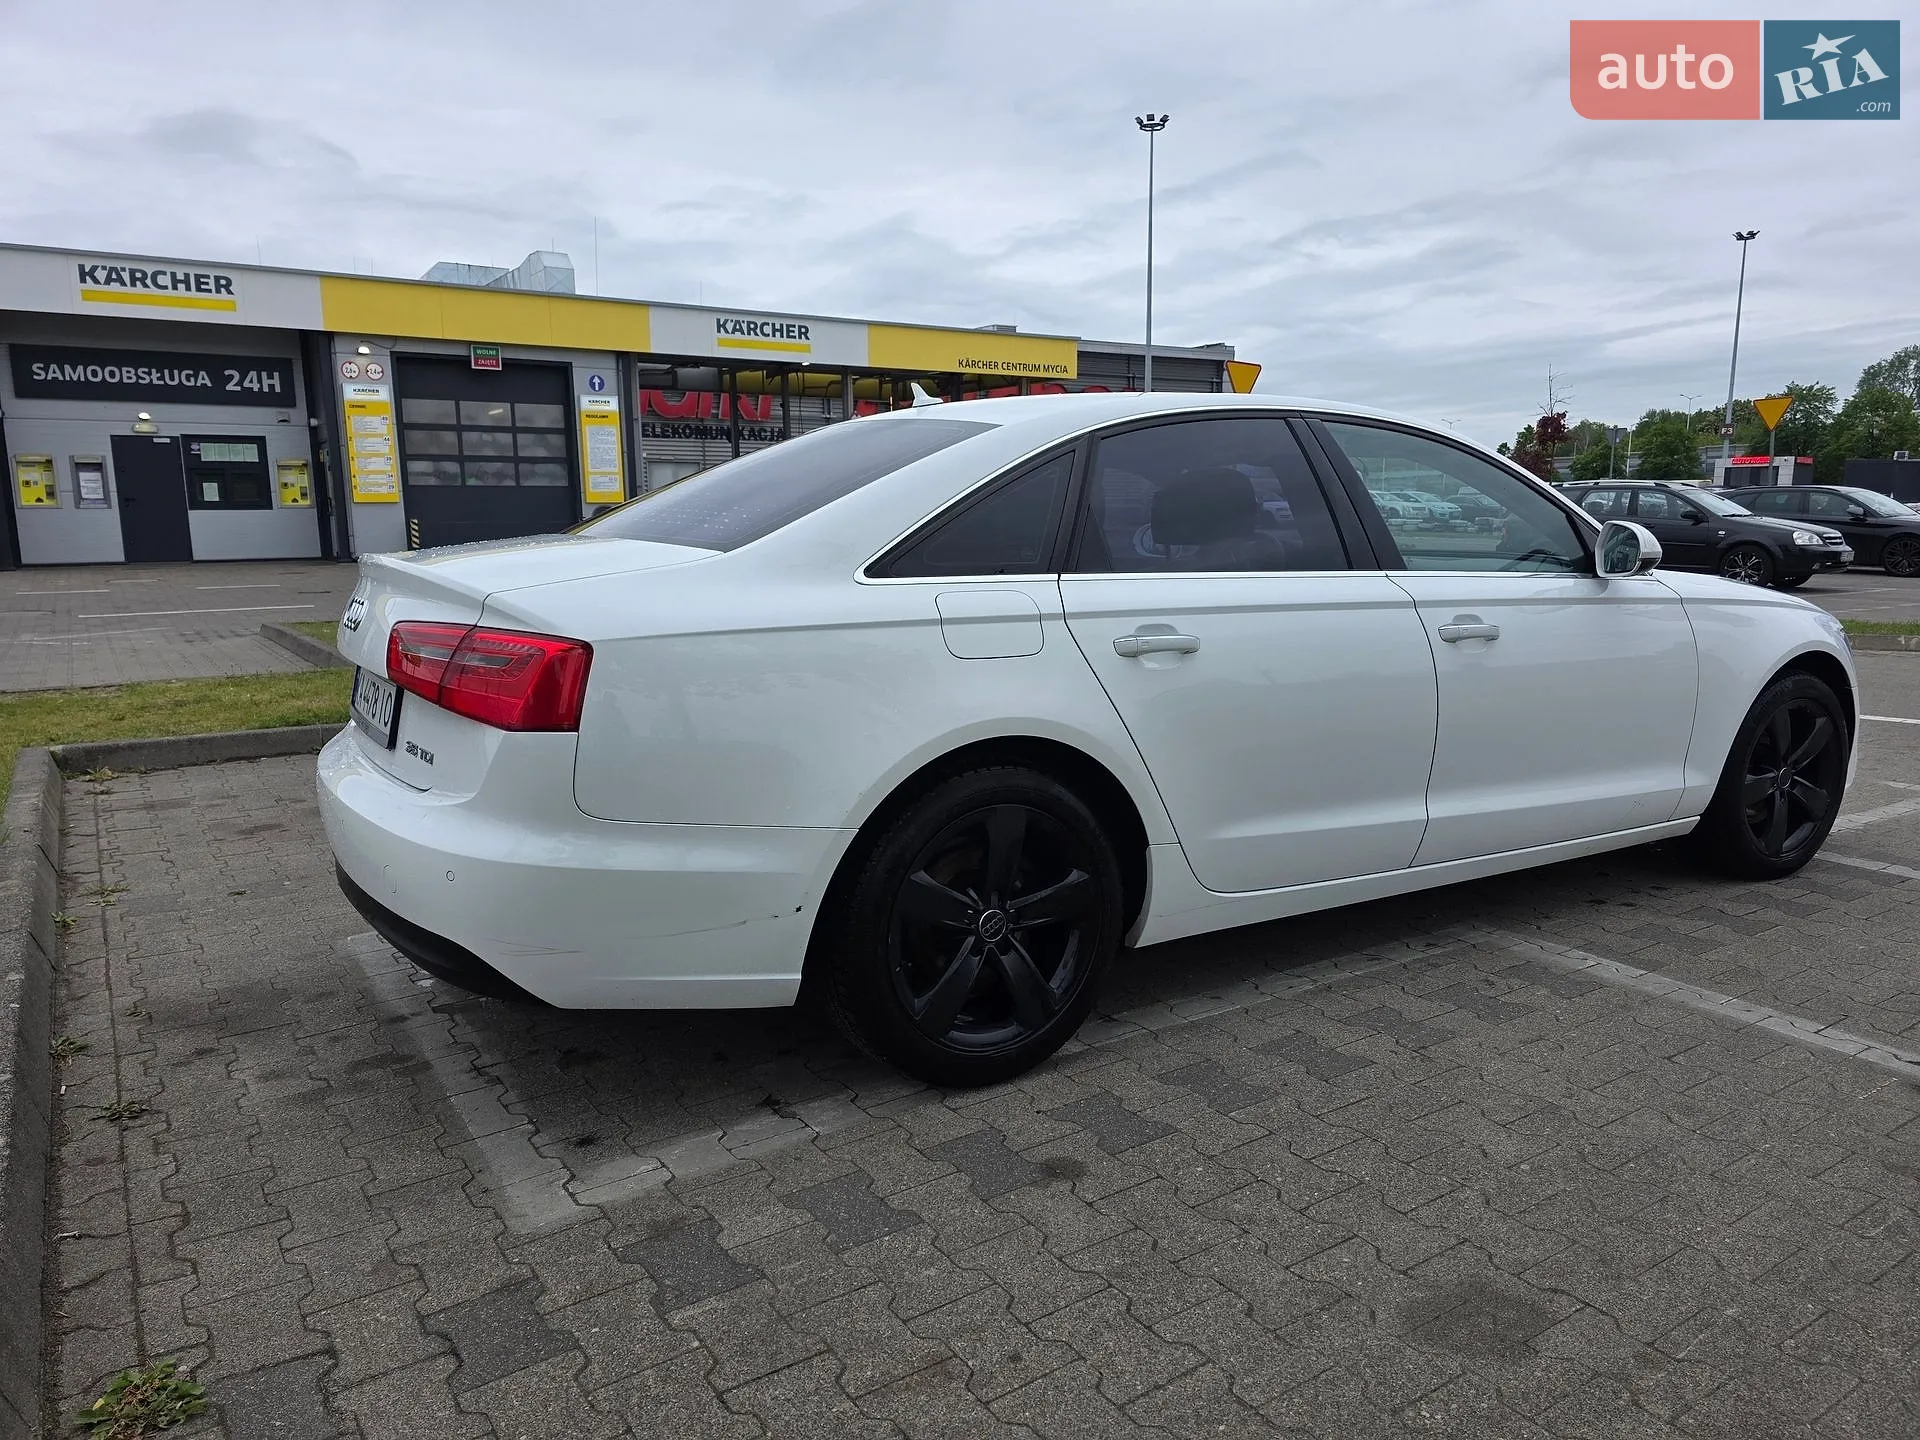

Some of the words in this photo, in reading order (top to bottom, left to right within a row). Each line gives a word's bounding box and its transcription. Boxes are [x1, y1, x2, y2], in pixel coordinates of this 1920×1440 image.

[77, 263, 235, 295] KÄRCHER
[716, 317, 810, 340] KÄRCHER
[958, 357, 999, 370] KÄRCHER
[1001, 361, 1040, 373] CENTRUM
[1043, 364, 1068, 374] MYCIA
[31, 362, 212, 388] SAMOOBSŁUGA
[223, 369, 281, 393] 24H
[1721, 427, 1733, 435] F3
